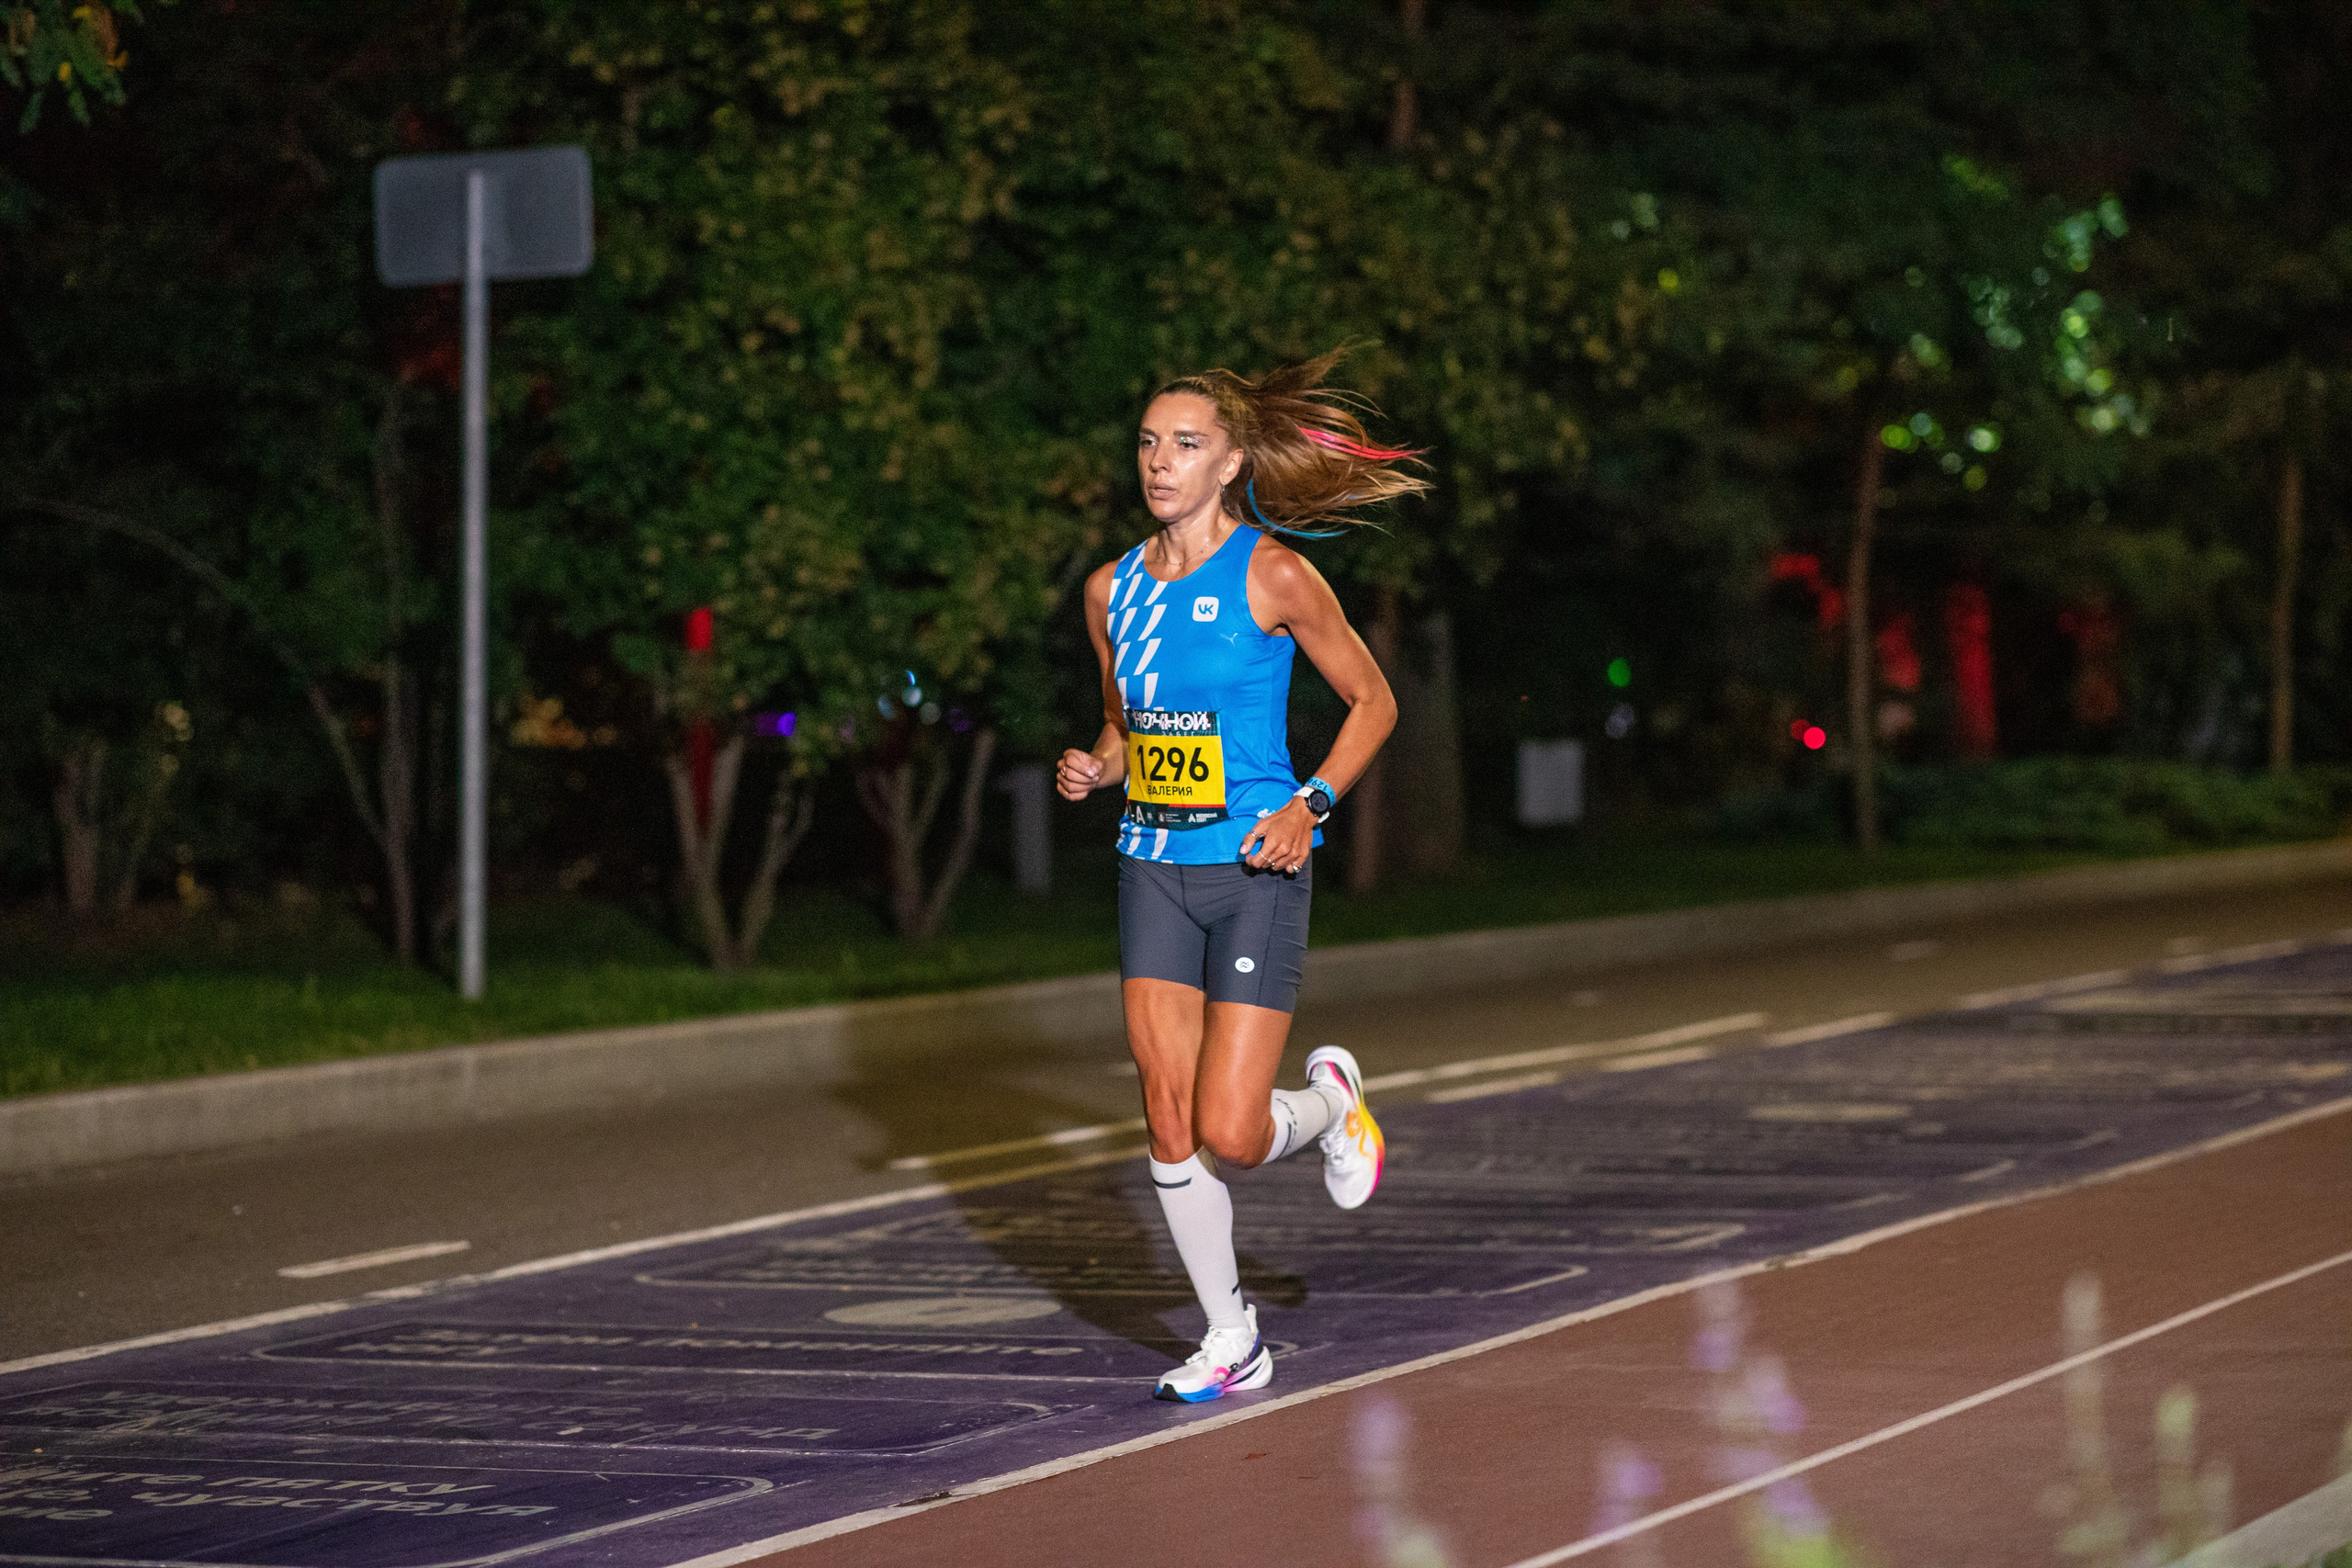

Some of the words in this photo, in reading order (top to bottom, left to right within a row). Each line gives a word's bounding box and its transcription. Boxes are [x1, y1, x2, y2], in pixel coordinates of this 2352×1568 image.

[1137, 744, 1209, 783] 1296
[1148, 785, 1193, 796] ВАЛЕРИЯ
[204, 1475, 496, 1496] пятку
[130, 1492, 559, 1516] чувствуя
